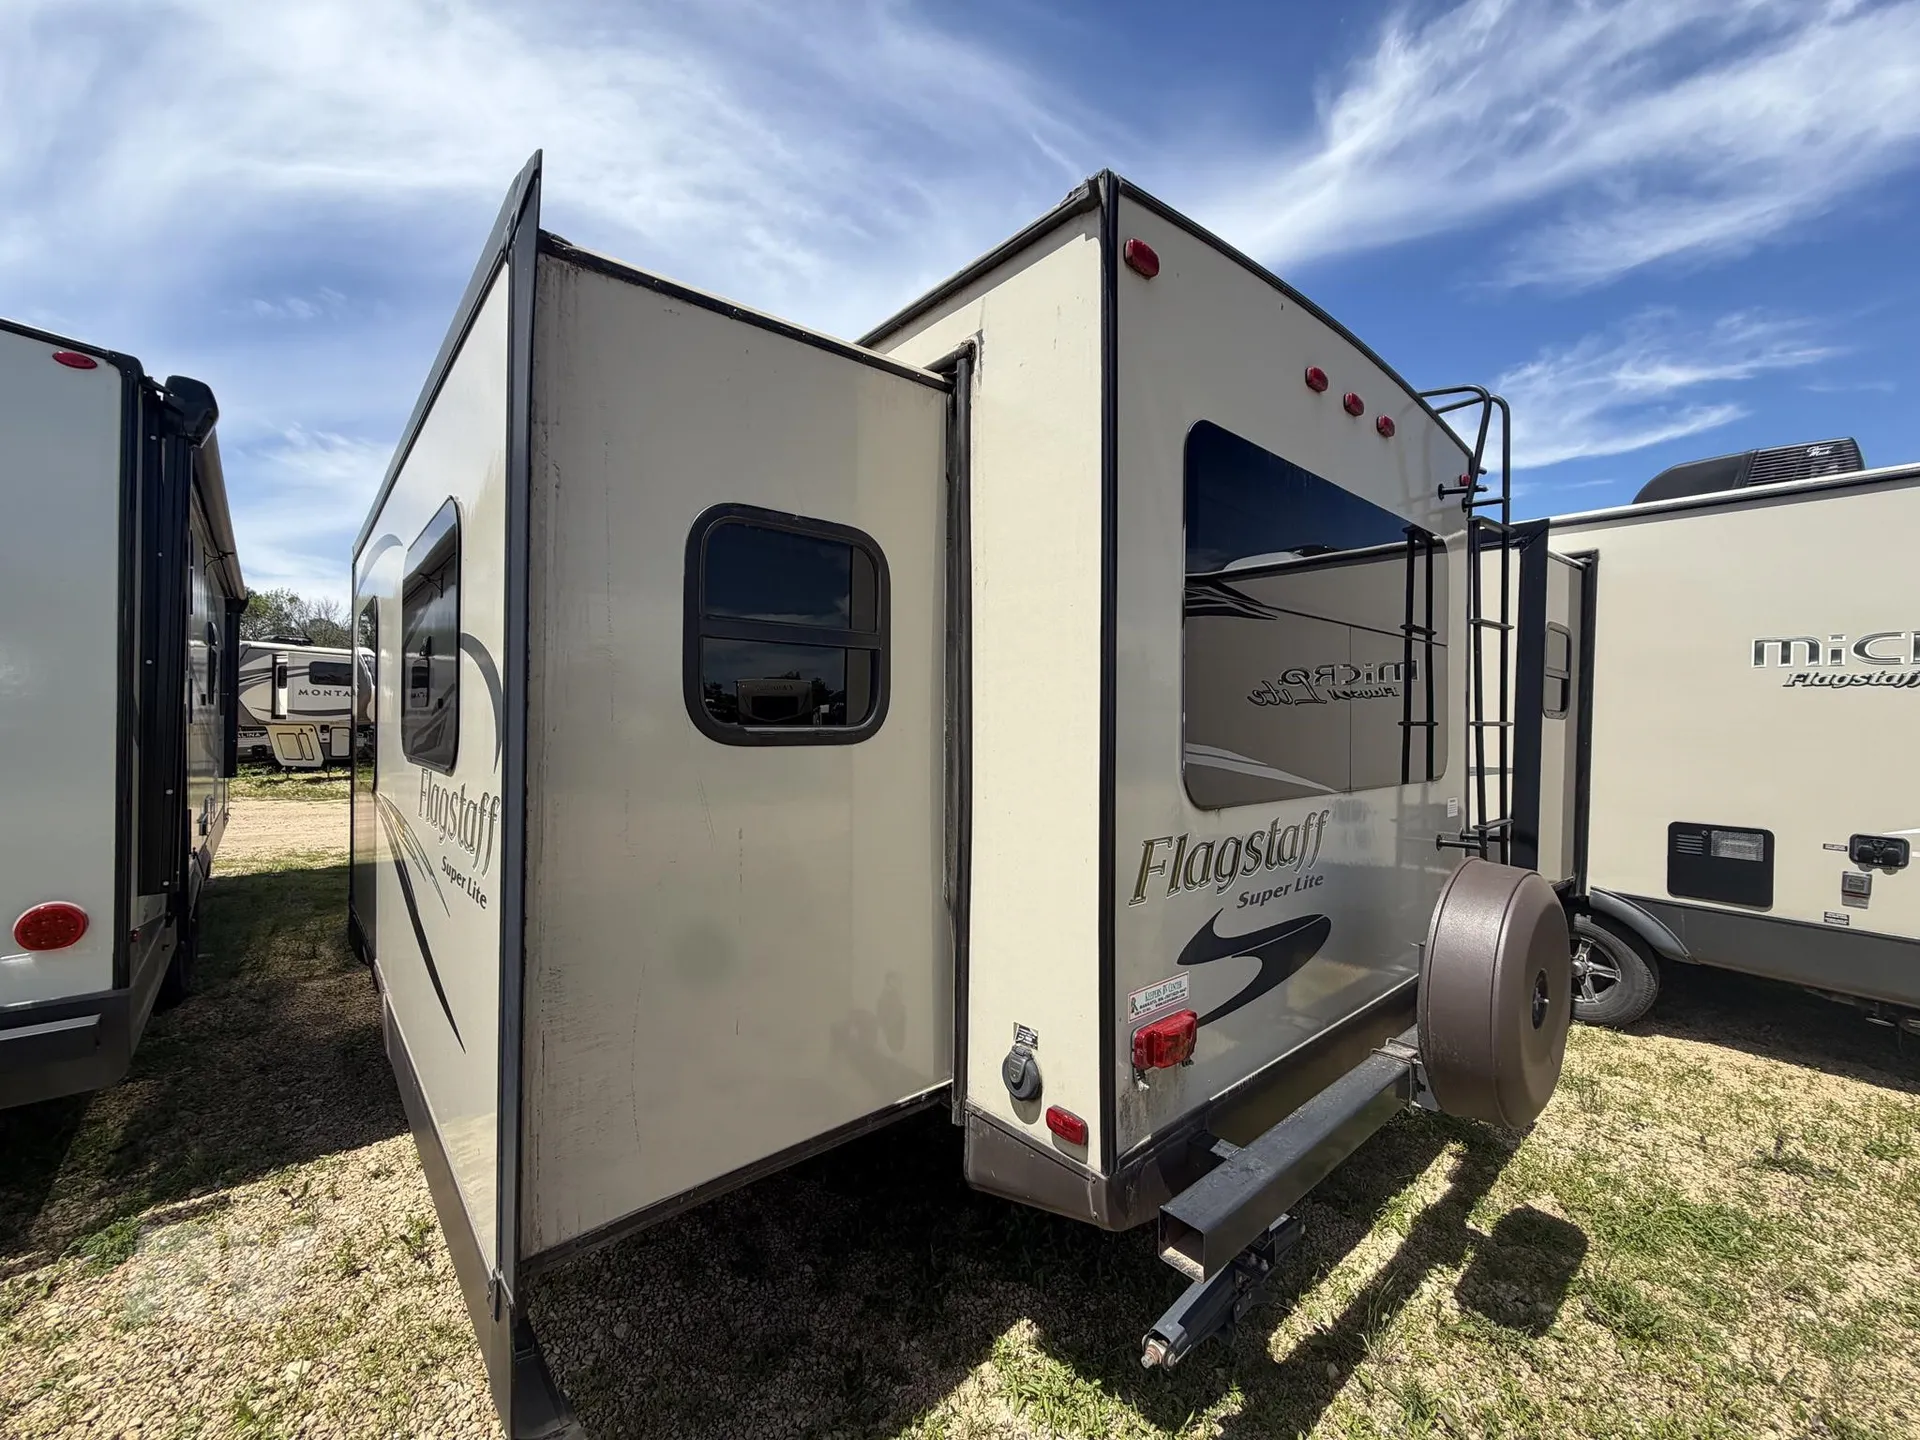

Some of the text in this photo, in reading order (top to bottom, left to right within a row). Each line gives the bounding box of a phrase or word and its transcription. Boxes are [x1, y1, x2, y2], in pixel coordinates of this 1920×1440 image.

[418, 767, 500, 879] Flagstaff
[1128, 809, 1330, 907] Flagstaff
[441, 855, 488, 910] Super Lite
[1236, 874, 1324, 909] Super Lite
